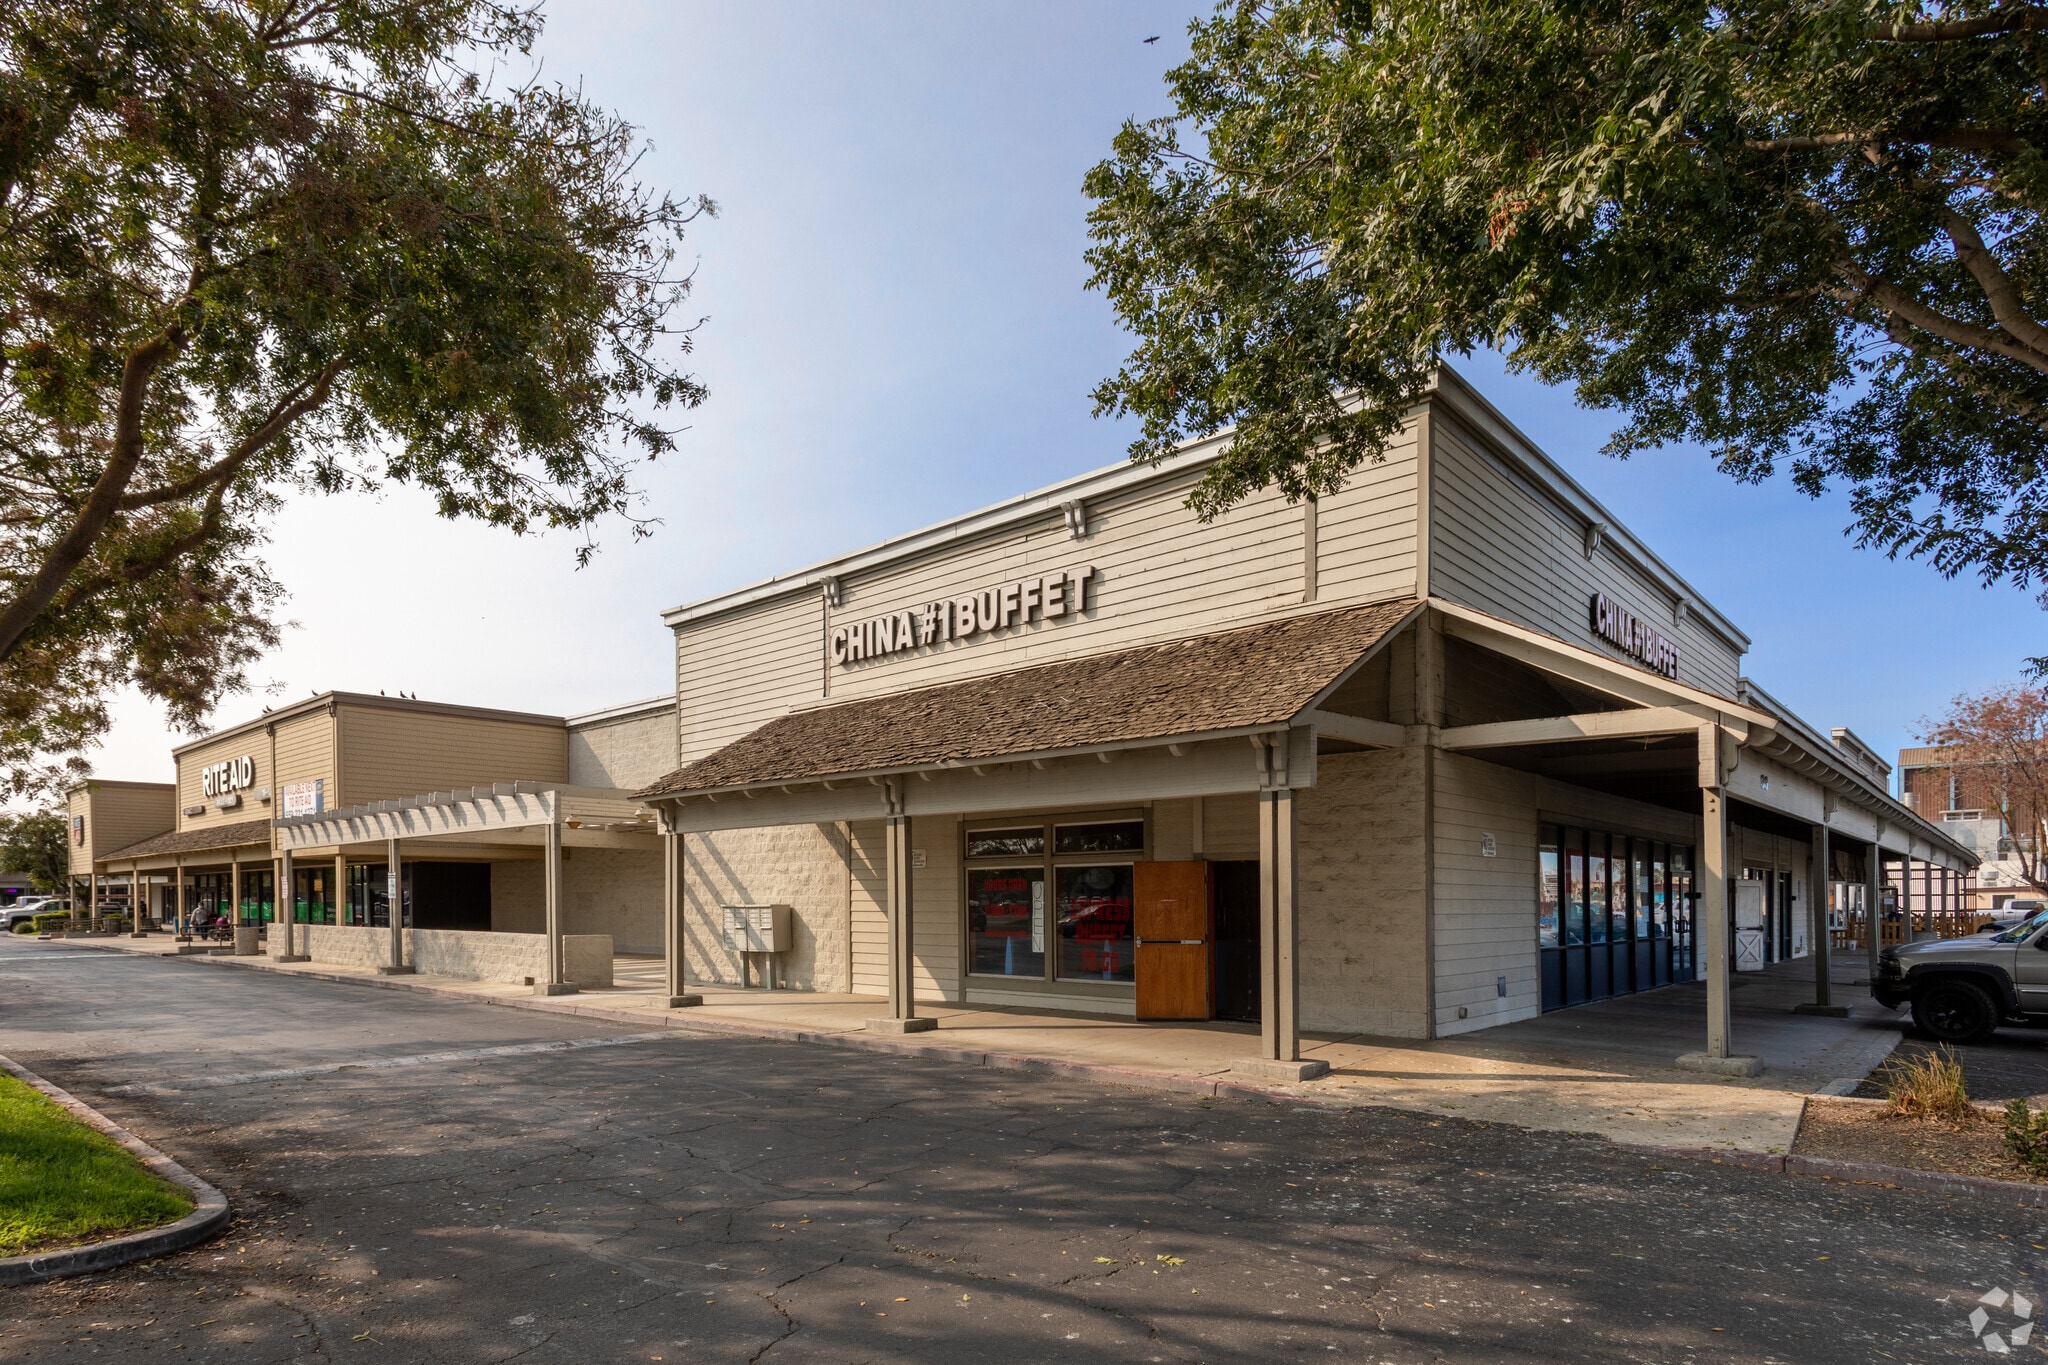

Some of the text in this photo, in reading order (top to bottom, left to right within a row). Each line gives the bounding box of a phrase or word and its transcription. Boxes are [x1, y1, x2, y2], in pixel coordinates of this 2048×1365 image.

[831, 611, 915, 665] CHINA
[956, 565, 1096, 637] BUFFET
[1593, 592, 1633, 653] CHINA
[202, 755, 253, 797] RITE AID
[1033, 882, 1043, 952] OPEN
[1075, 923, 1126, 946] BUFFET
[1081, 949, 1120, 973] TO GO
